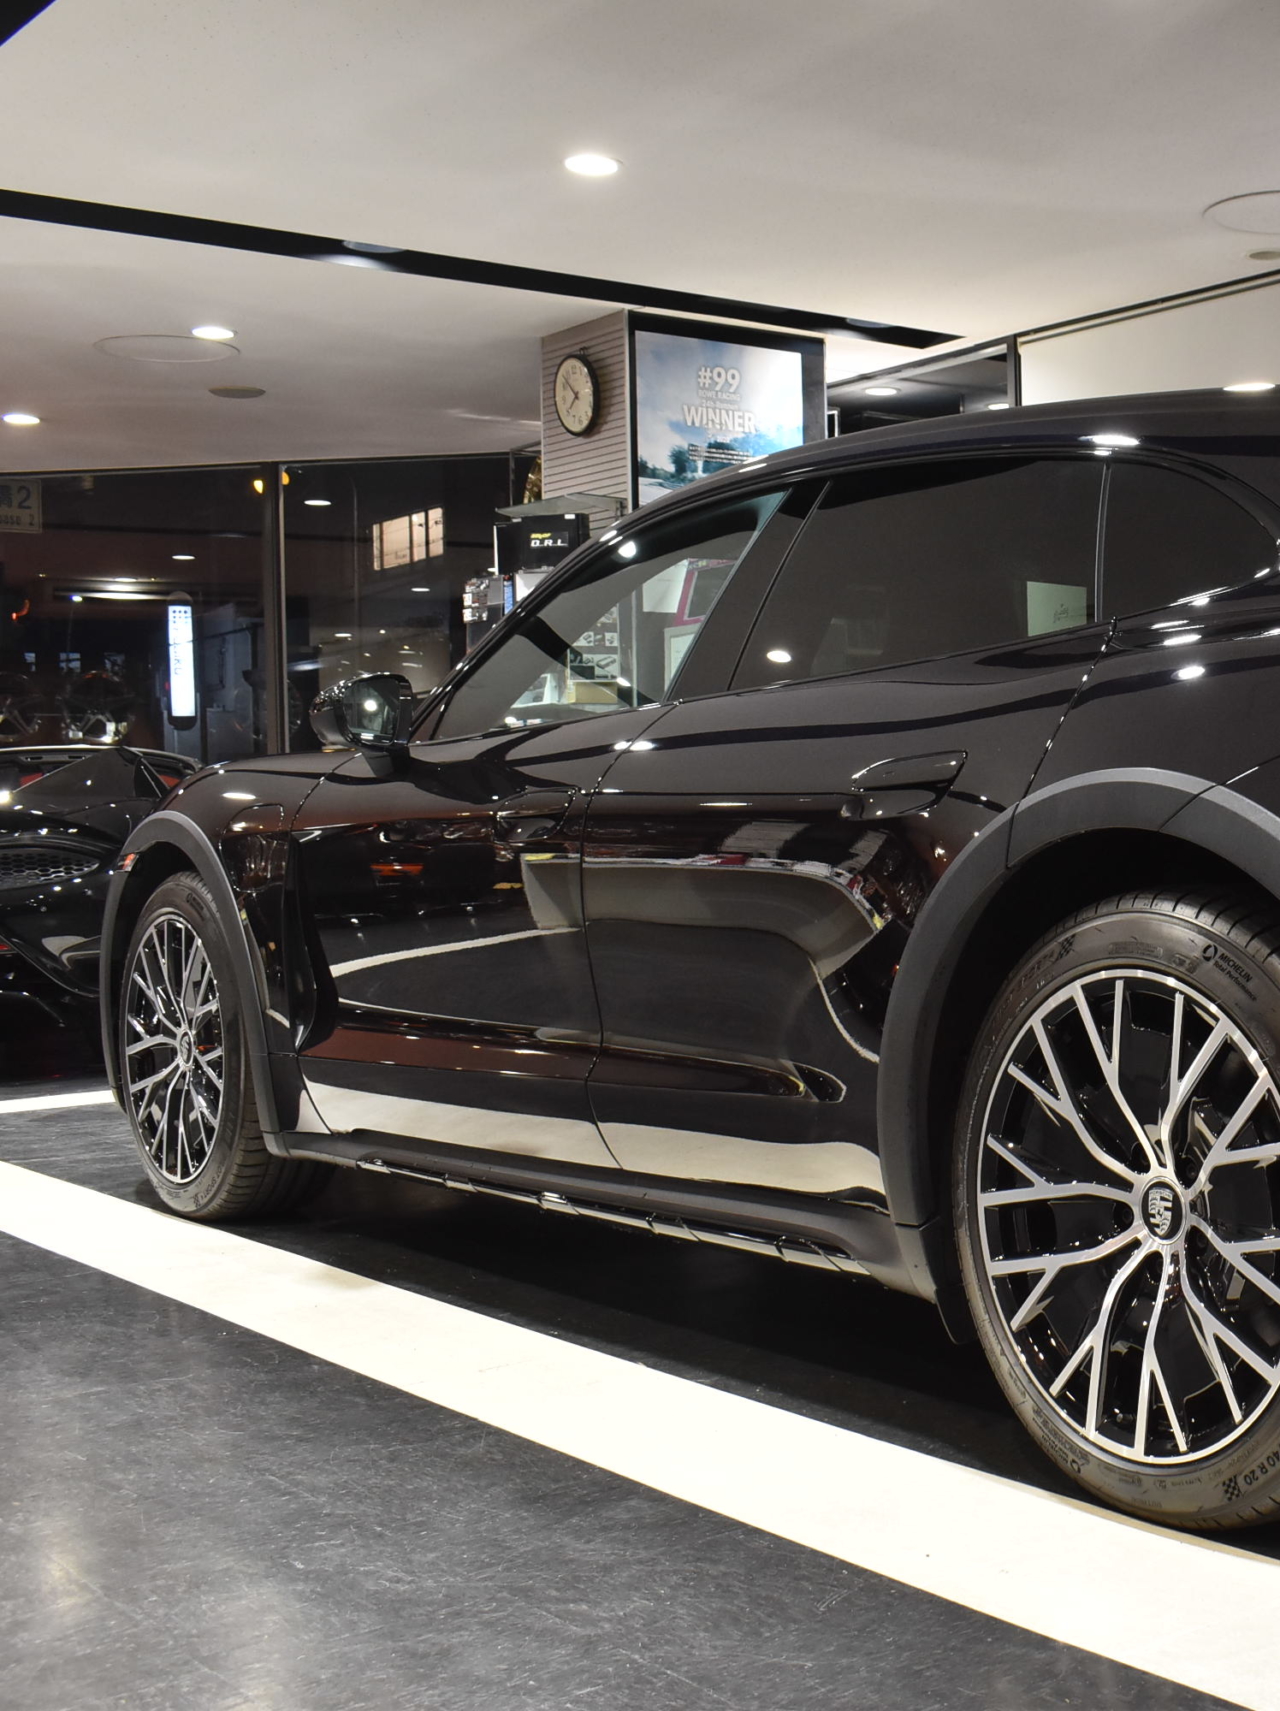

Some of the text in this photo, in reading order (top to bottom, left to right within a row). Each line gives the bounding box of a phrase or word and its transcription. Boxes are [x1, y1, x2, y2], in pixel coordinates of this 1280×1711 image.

[698, 366, 741, 393] #99
[682, 404, 757, 434] WINNER
[1219, 953, 1253, 983] MICHELIN
[1243, 1468, 1260, 1486] 20
[1257, 1464, 1269, 1475] R
